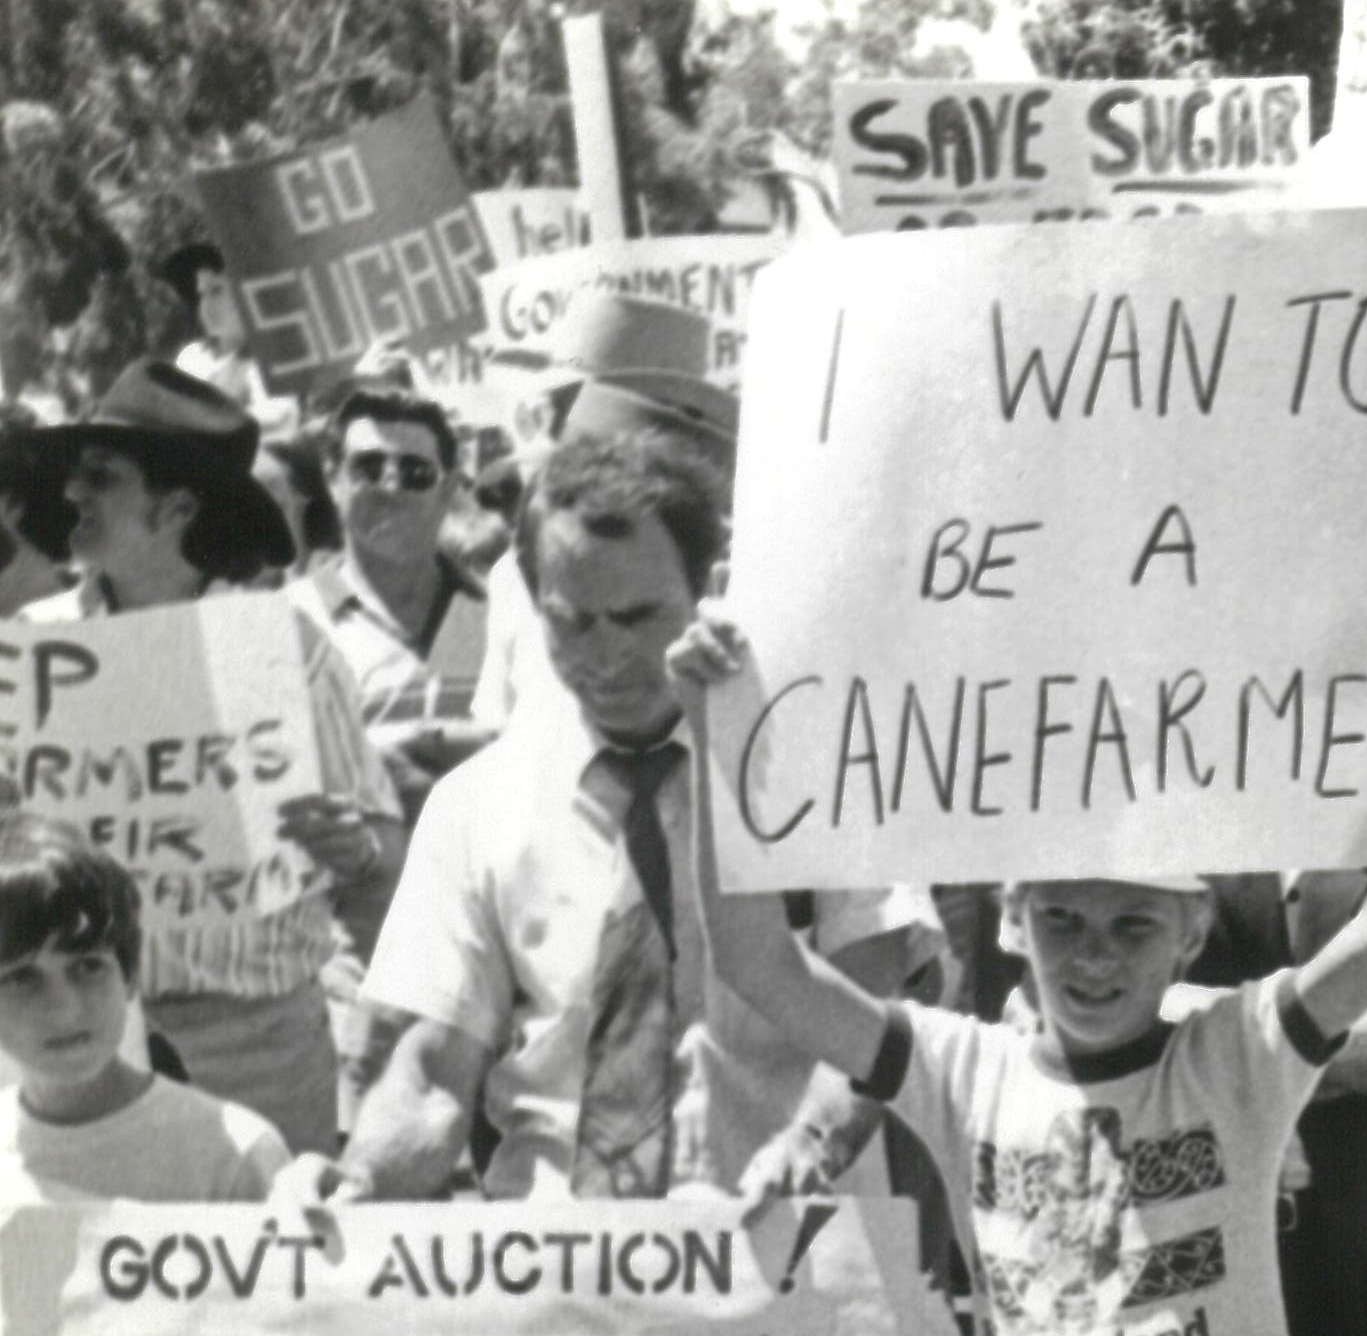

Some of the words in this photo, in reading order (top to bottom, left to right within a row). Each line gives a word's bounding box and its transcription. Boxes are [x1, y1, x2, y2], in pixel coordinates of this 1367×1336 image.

[850, 88, 1051, 188] SAVE
[1087, 84, 1298, 177] SUGAR
[275, 145, 374, 236] GO
[242, 204, 492, 379] SUGAR
[819, 308, 845, 444] I
[992, 292, 1237, 423] WAN
[920, 517, 1044, 600] BE
[1131, 503, 1198, 588] A
[3, 718, 290, 800] RMERS
